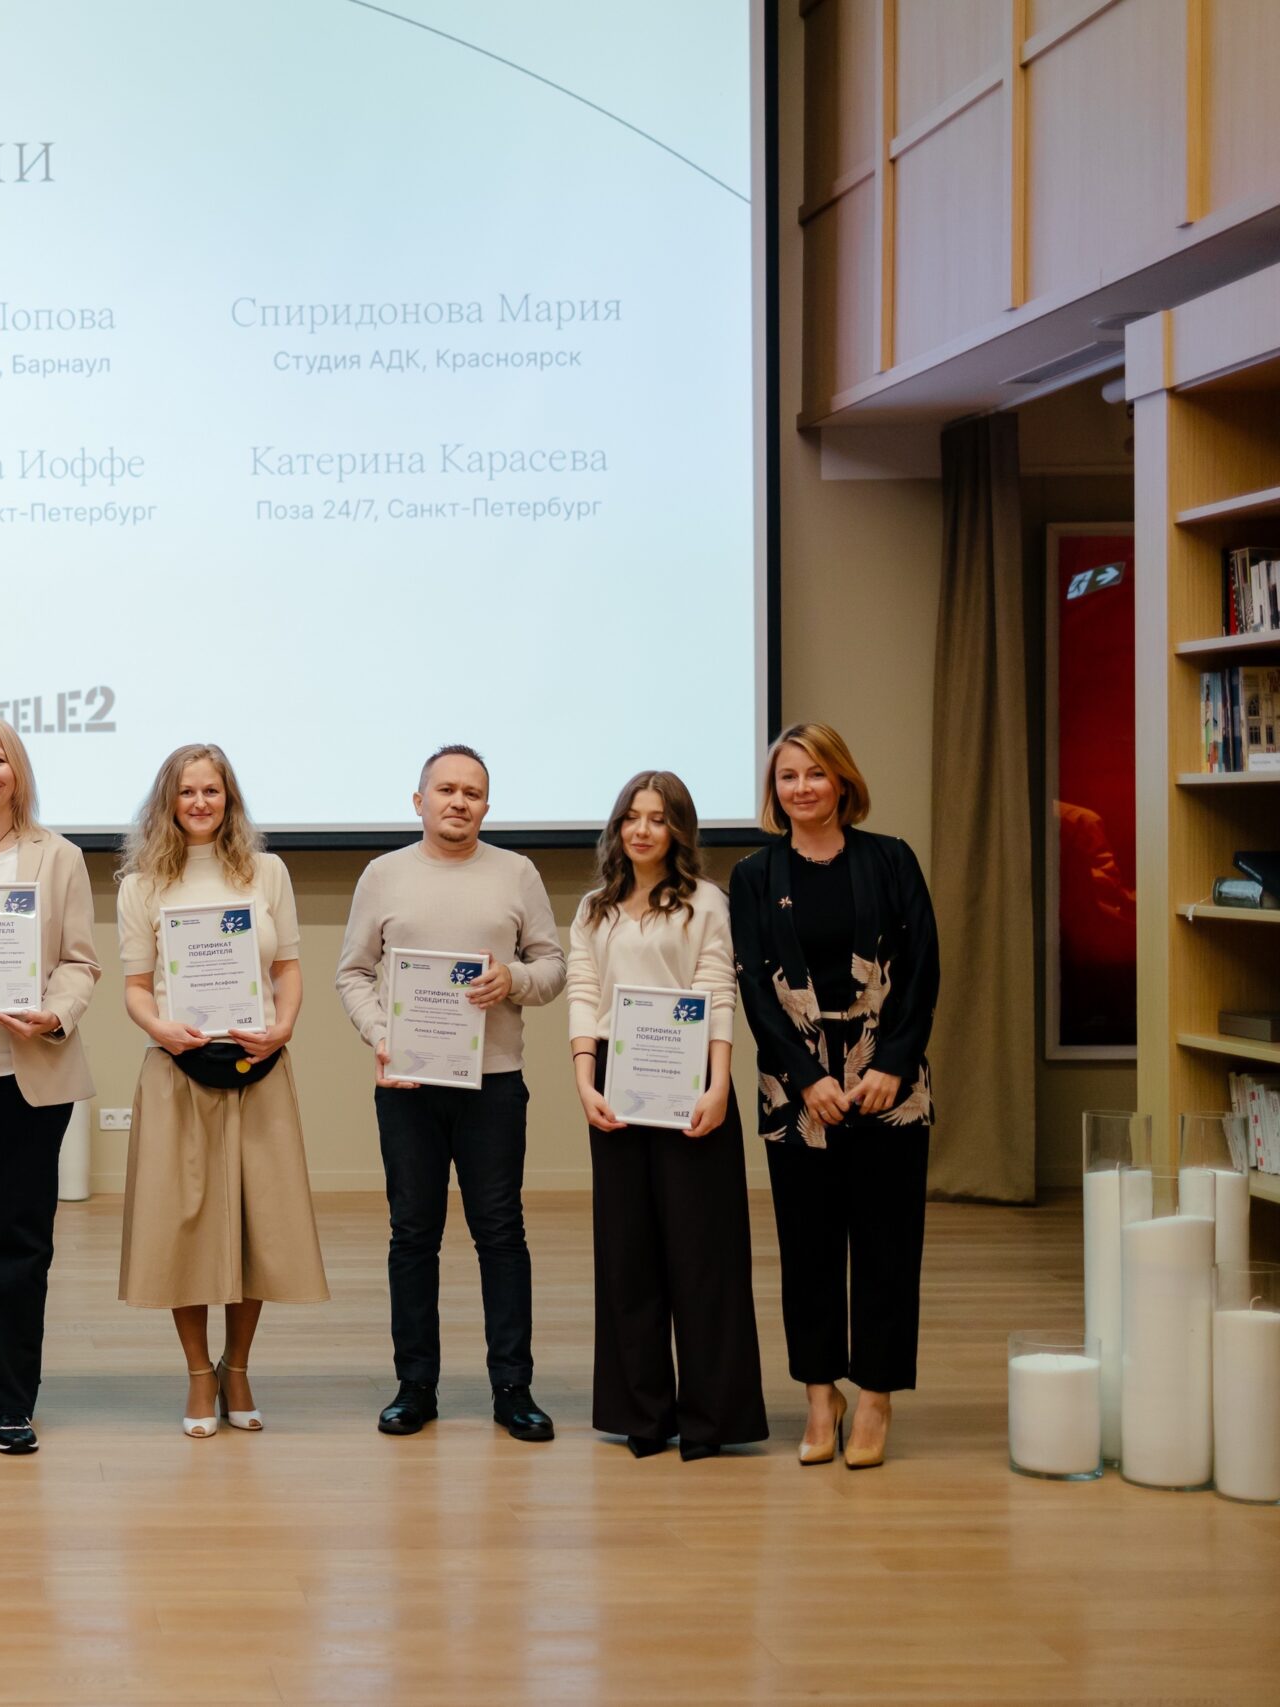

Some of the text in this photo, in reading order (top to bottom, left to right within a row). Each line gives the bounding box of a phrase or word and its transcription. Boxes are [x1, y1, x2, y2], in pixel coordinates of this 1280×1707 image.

[231, 293, 621, 334] Спиридонова Мария
[12, 354, 110, 379] Барнаул
[273, 348, 581, 375] Студия АДК, Красноярск
[18, 446, 144, 487] Иоффе
[251, 444, 608, 483] Катерина Карасева
[257, 496, 602, 523] Поза 24/7, Санкт-Петербург
[188, 942, 232, 950] СЕРТИФИКАТ
[188, 949, 233, 957] ПОБЕДИТЕЛЯ
[414, 996, 459, 1004] ПОБЕДИТЕЛЯ
[415, 989, 459, 997] СЕРТИФИКАТ
[636, 1034, 681, 1042] ПОБЕДИТЕЛЯ
[637, 1026, 681, 1035] СЕРТИФИКАТ
